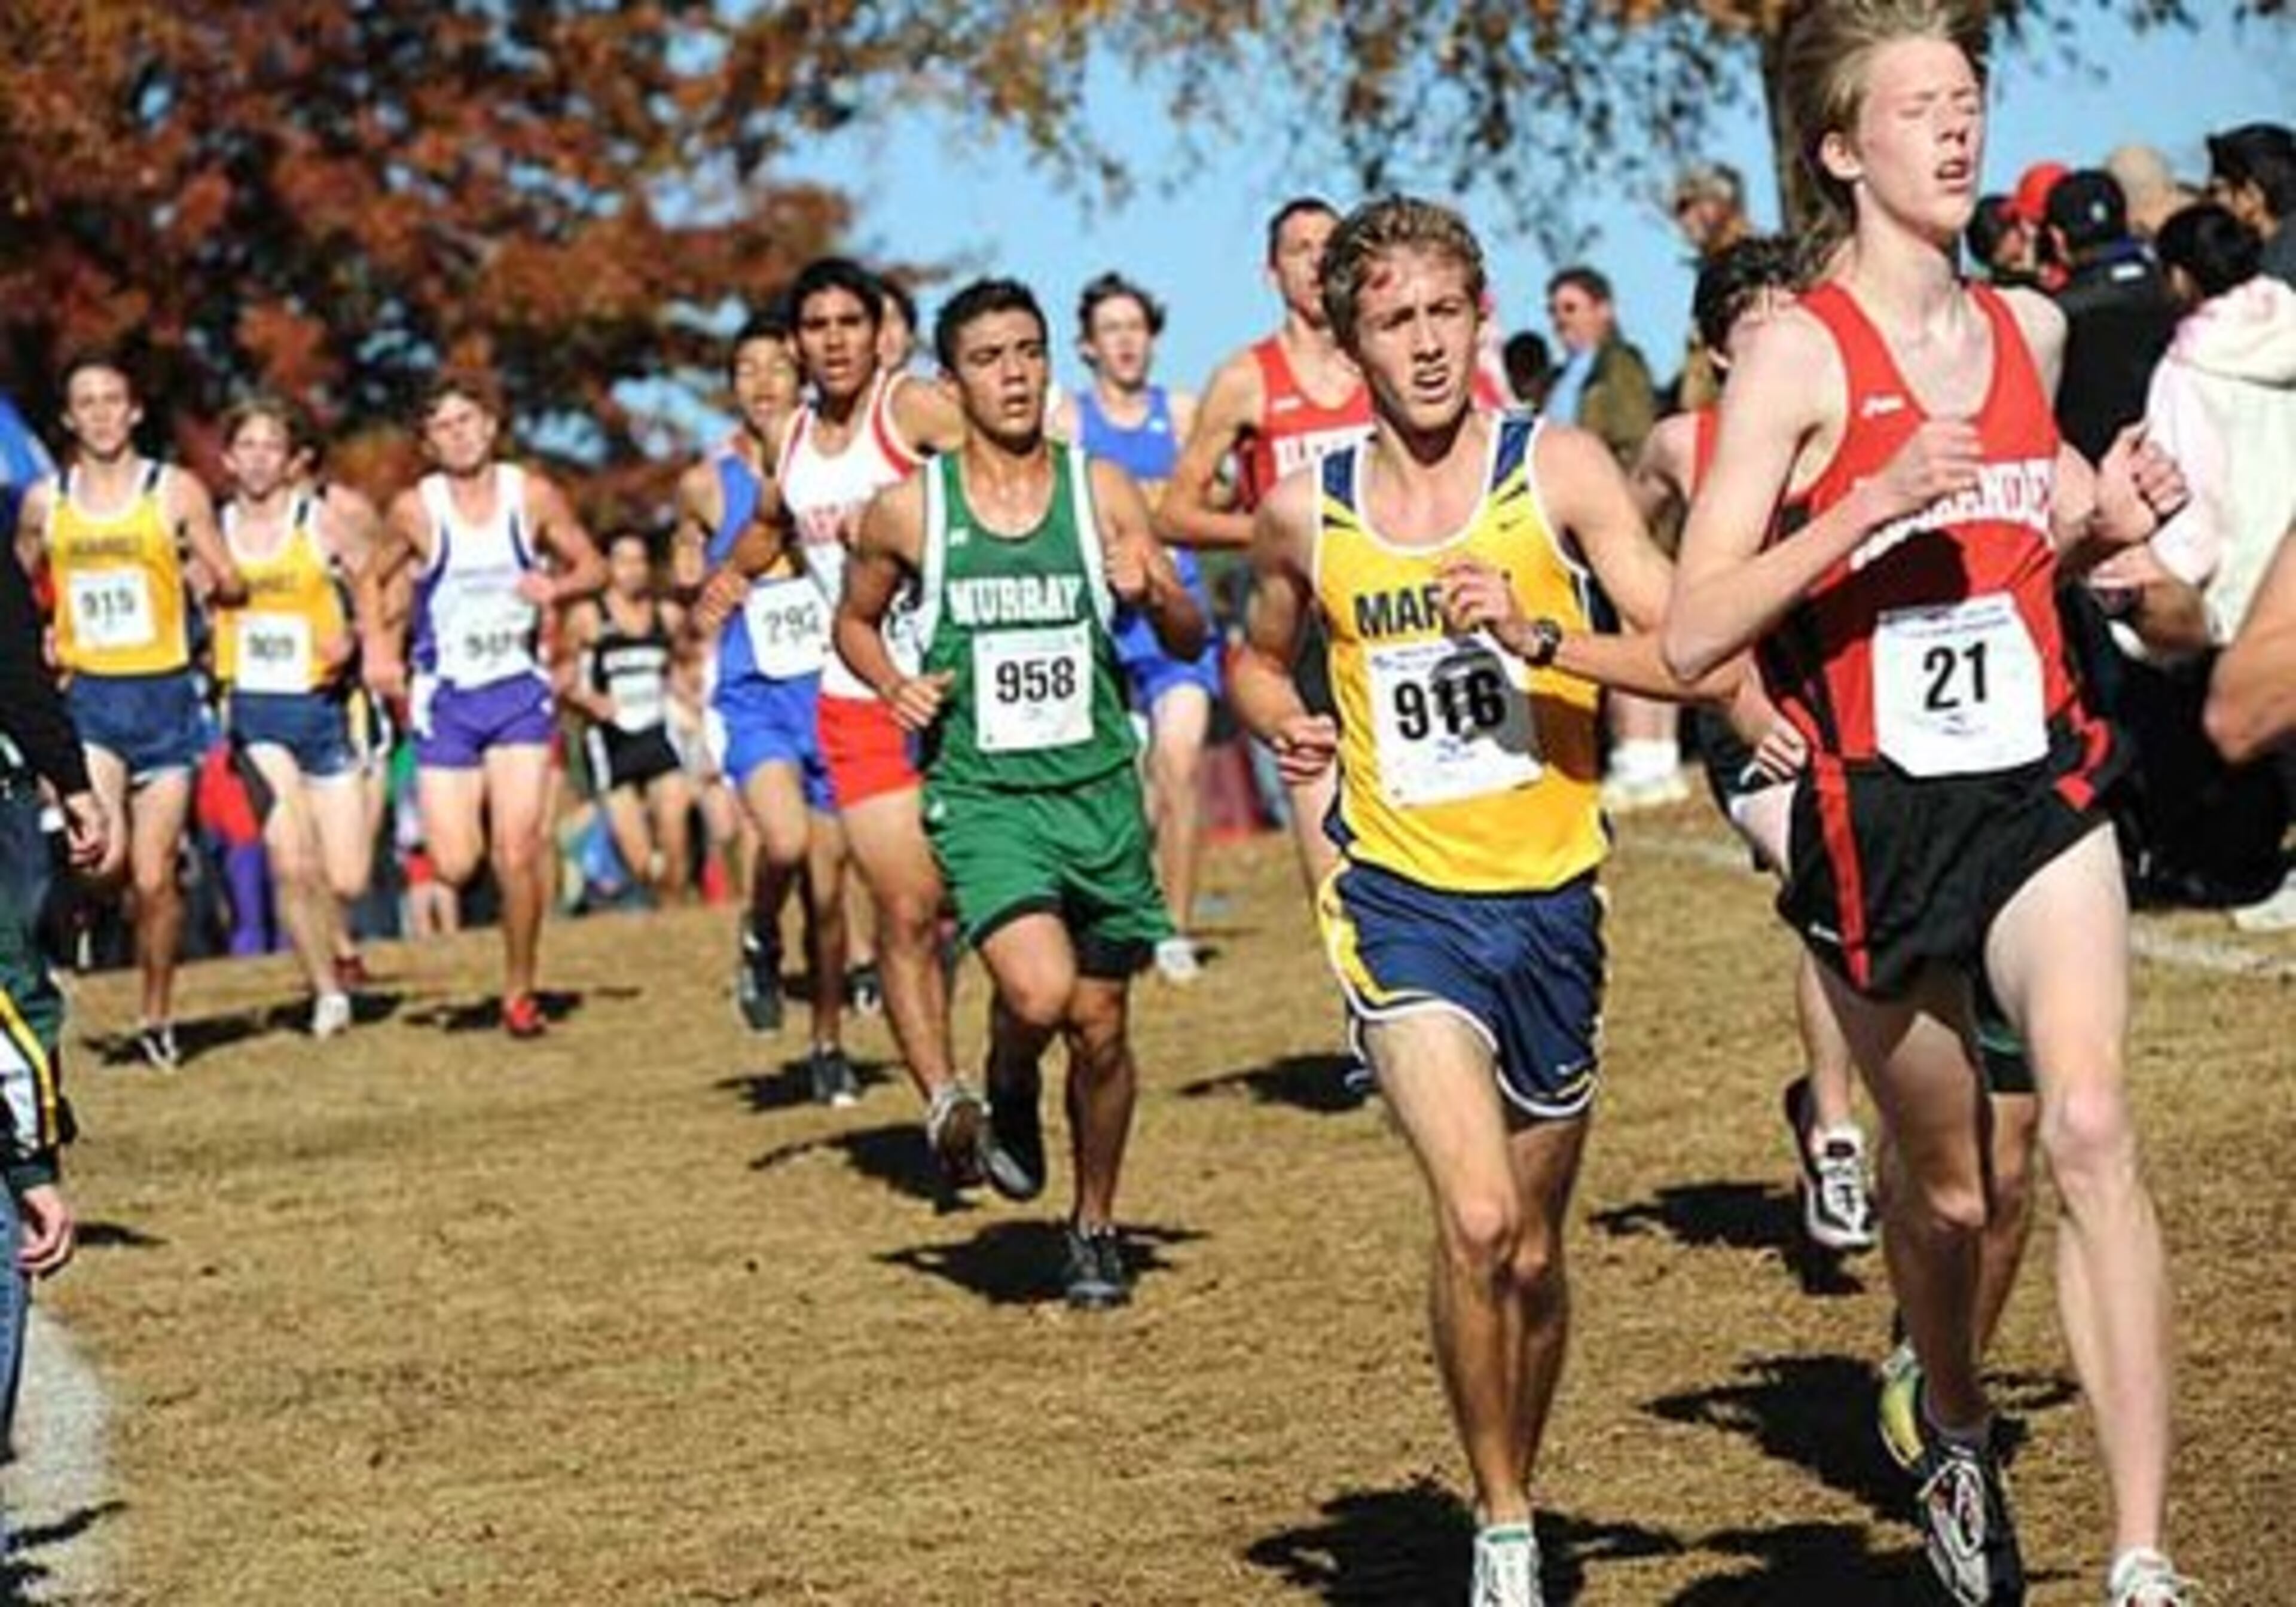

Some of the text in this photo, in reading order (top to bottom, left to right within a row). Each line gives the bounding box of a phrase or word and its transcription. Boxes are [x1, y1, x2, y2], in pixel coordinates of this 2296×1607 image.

[947, 573, 1083, 625] MURRAY
[1354, 582, 1444, 638] MAR
[995, 655, 1076, 704] 958
[1923, 640, 1986, 711] 21
[1394, 670, 1506, 741] 916
